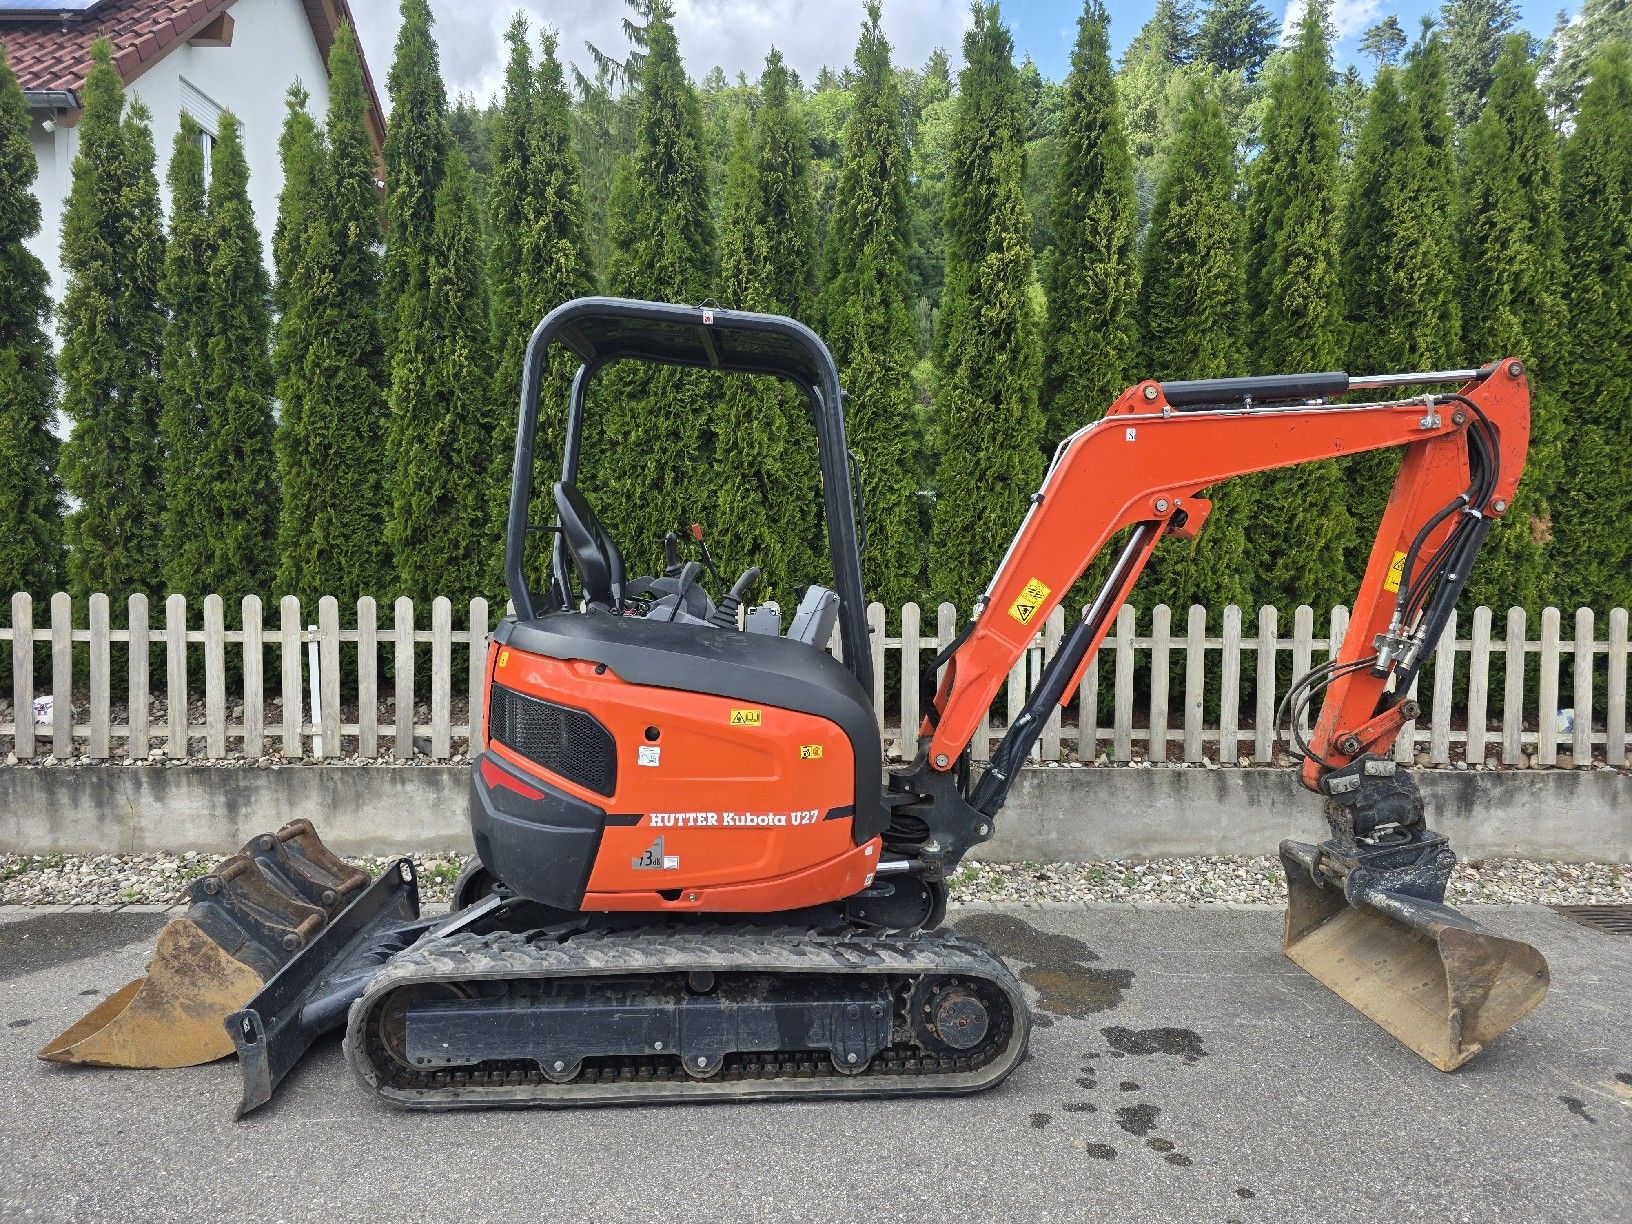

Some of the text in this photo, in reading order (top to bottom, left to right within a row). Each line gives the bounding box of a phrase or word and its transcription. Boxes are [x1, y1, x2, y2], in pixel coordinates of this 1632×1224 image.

[649, 810, 819, 827] HUTTER Kubota U27
